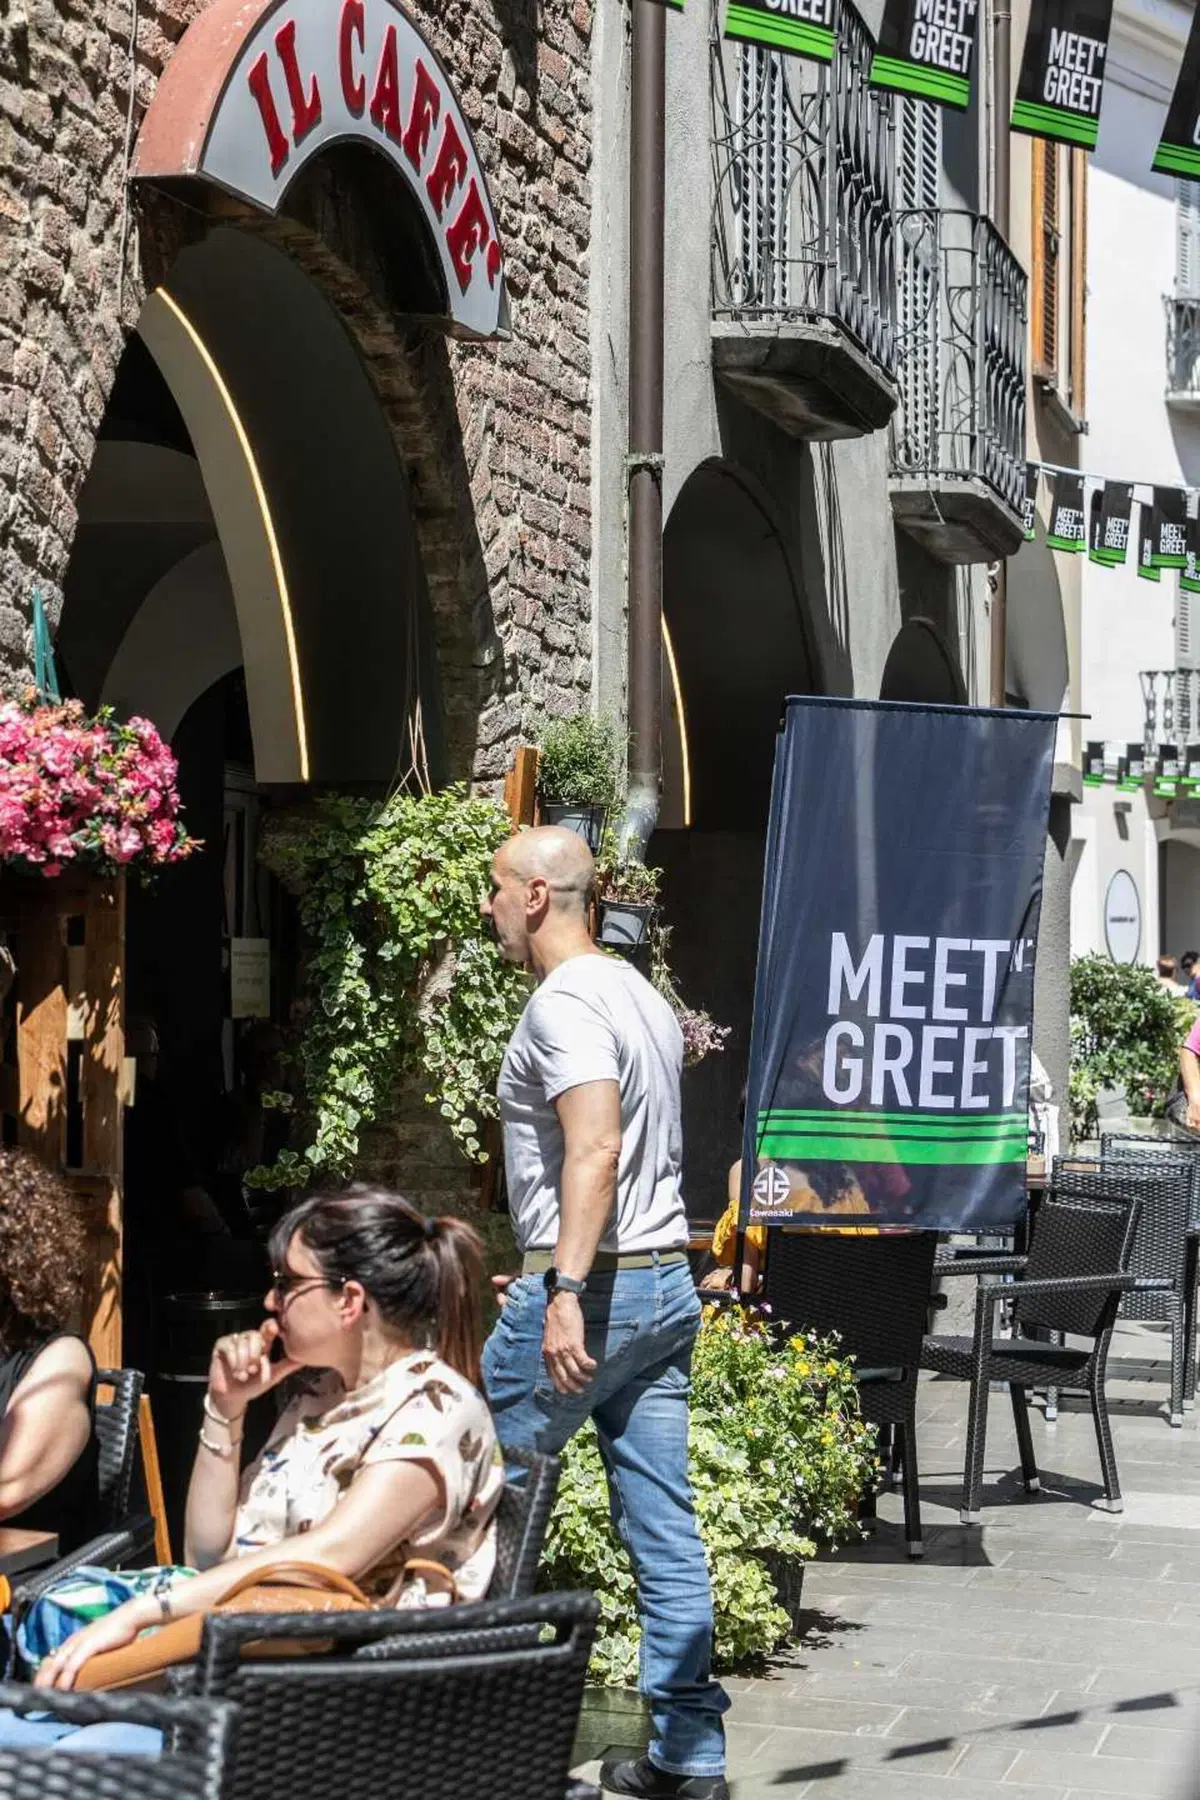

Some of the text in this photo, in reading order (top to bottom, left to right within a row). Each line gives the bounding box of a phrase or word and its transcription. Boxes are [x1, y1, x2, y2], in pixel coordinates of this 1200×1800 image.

[909, 20, 973, 74] GREET
[247, 19, 322, 180] IL
[1043, 65, 1102, 114] GREET
[1160, 538, 1187, 555] GREET
[822, 1021, 1028, 1109] GREET
